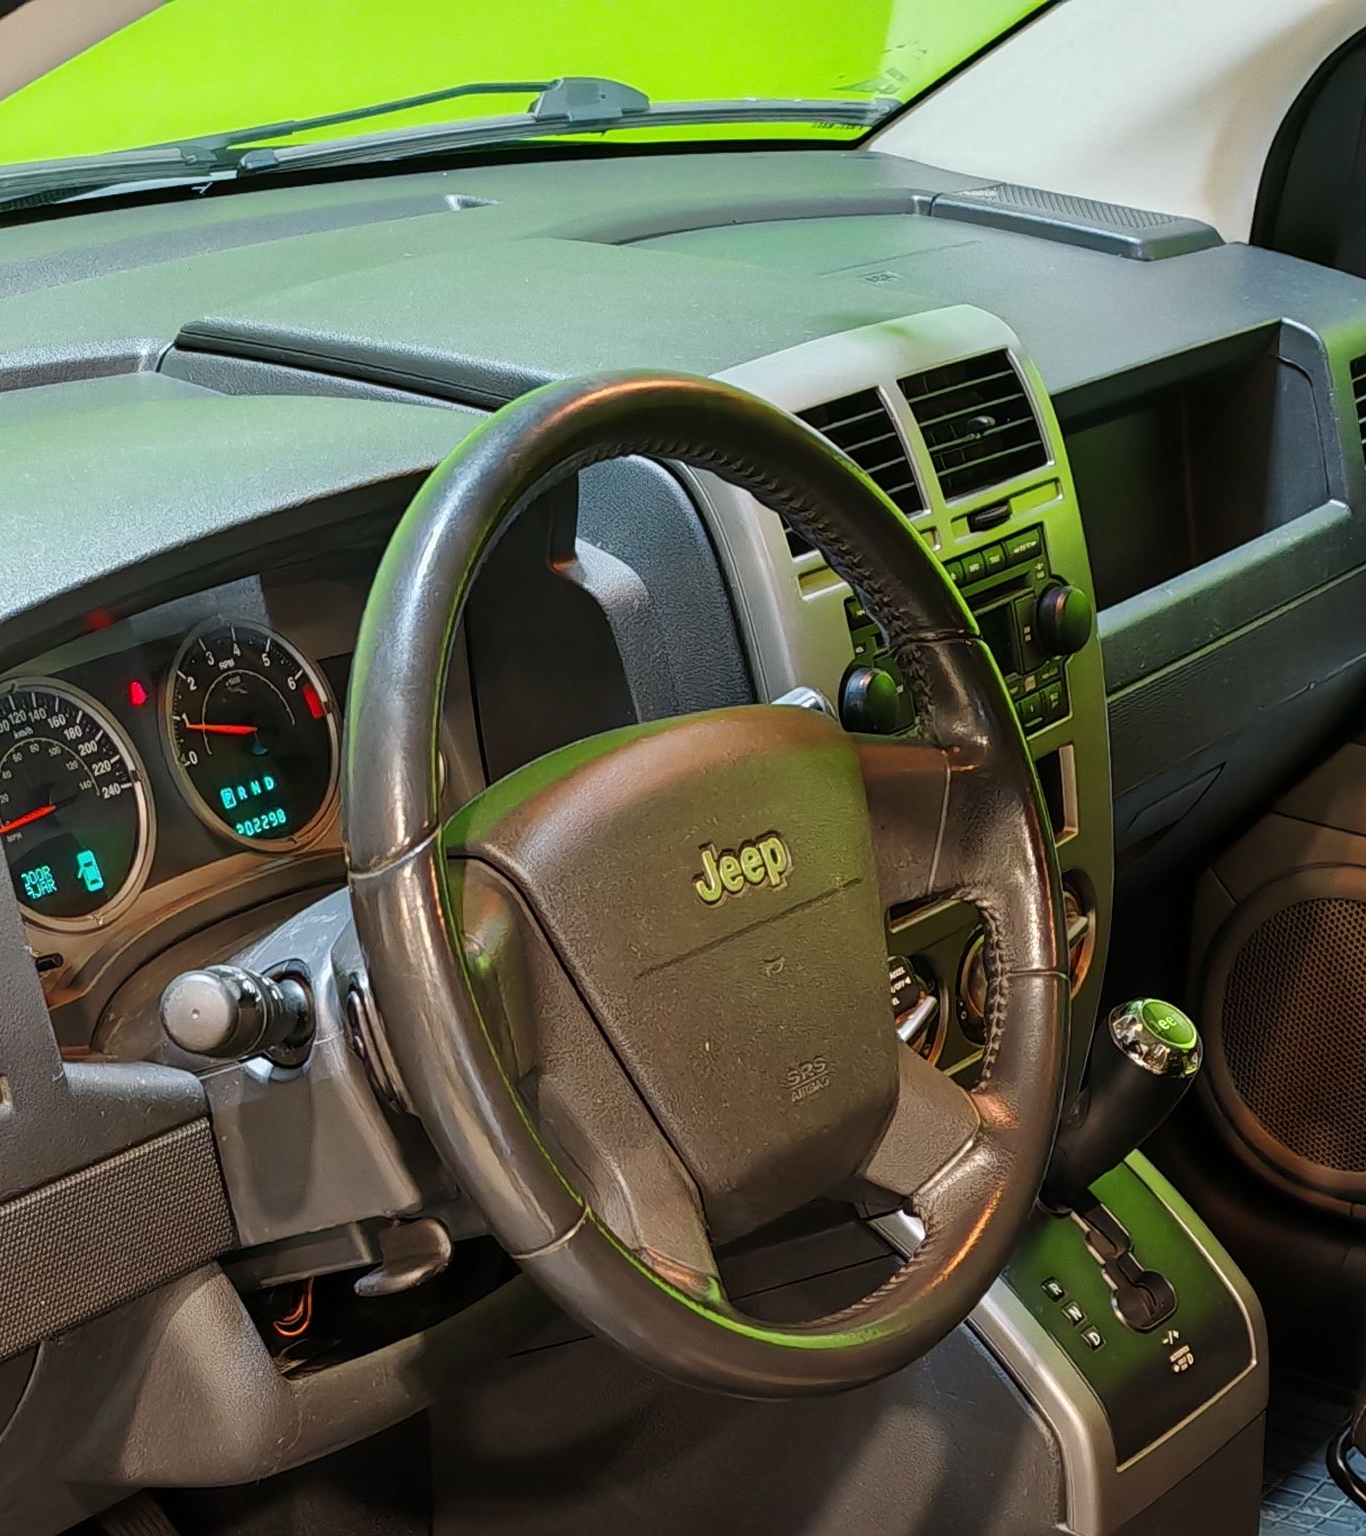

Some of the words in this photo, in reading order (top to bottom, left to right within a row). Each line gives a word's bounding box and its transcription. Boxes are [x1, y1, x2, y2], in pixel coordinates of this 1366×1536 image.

[233, 643, 241, 656] 4
[205, 651, 214, 666] 3
[261, 653, 271, 667] 5
[187, 677, 197, 691] 2
[287, 676, 297, 690] 6
[8, 710, 27, 725] 120
[28, 707, 47, 723] 140
[47, 714, 66, 728] 160
[64, 725, 83, 740] 180
[78, 741, 98, 756] 200
[189, 751, 198, 765] 0
[92, 761, 111, 776] 220
[102, 783, 121, 799] 240
[237, 785, 248, 800] R
[250, 780, 261, 795] N
[263, 776, 274, 790] D
[695, 836, 787, 903] Jeep
[786, 1057, 827, 1085] SRS
[1048, 1282, 1062, 1296] R
[1068, 1306, 1083, 1317] N
[1089, 1332, 1101, 1346] D
